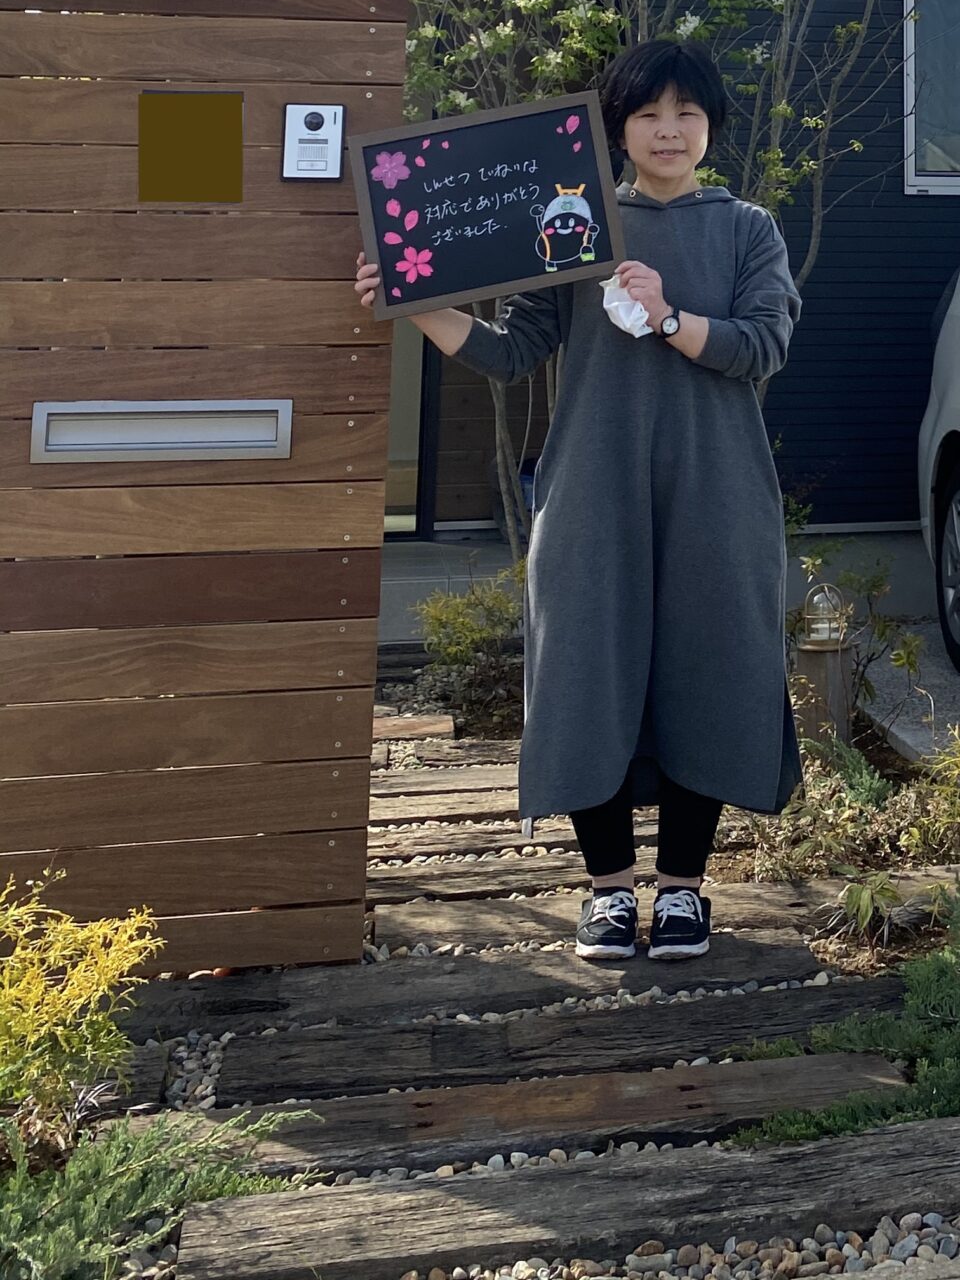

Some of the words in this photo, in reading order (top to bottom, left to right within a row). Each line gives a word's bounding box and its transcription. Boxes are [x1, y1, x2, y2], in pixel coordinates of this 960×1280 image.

[423, 173, 470, 193] しんせつ
[478, 159, 539, 181] ていねいな
[424, 183, 540, 225] 対応でありがとう
